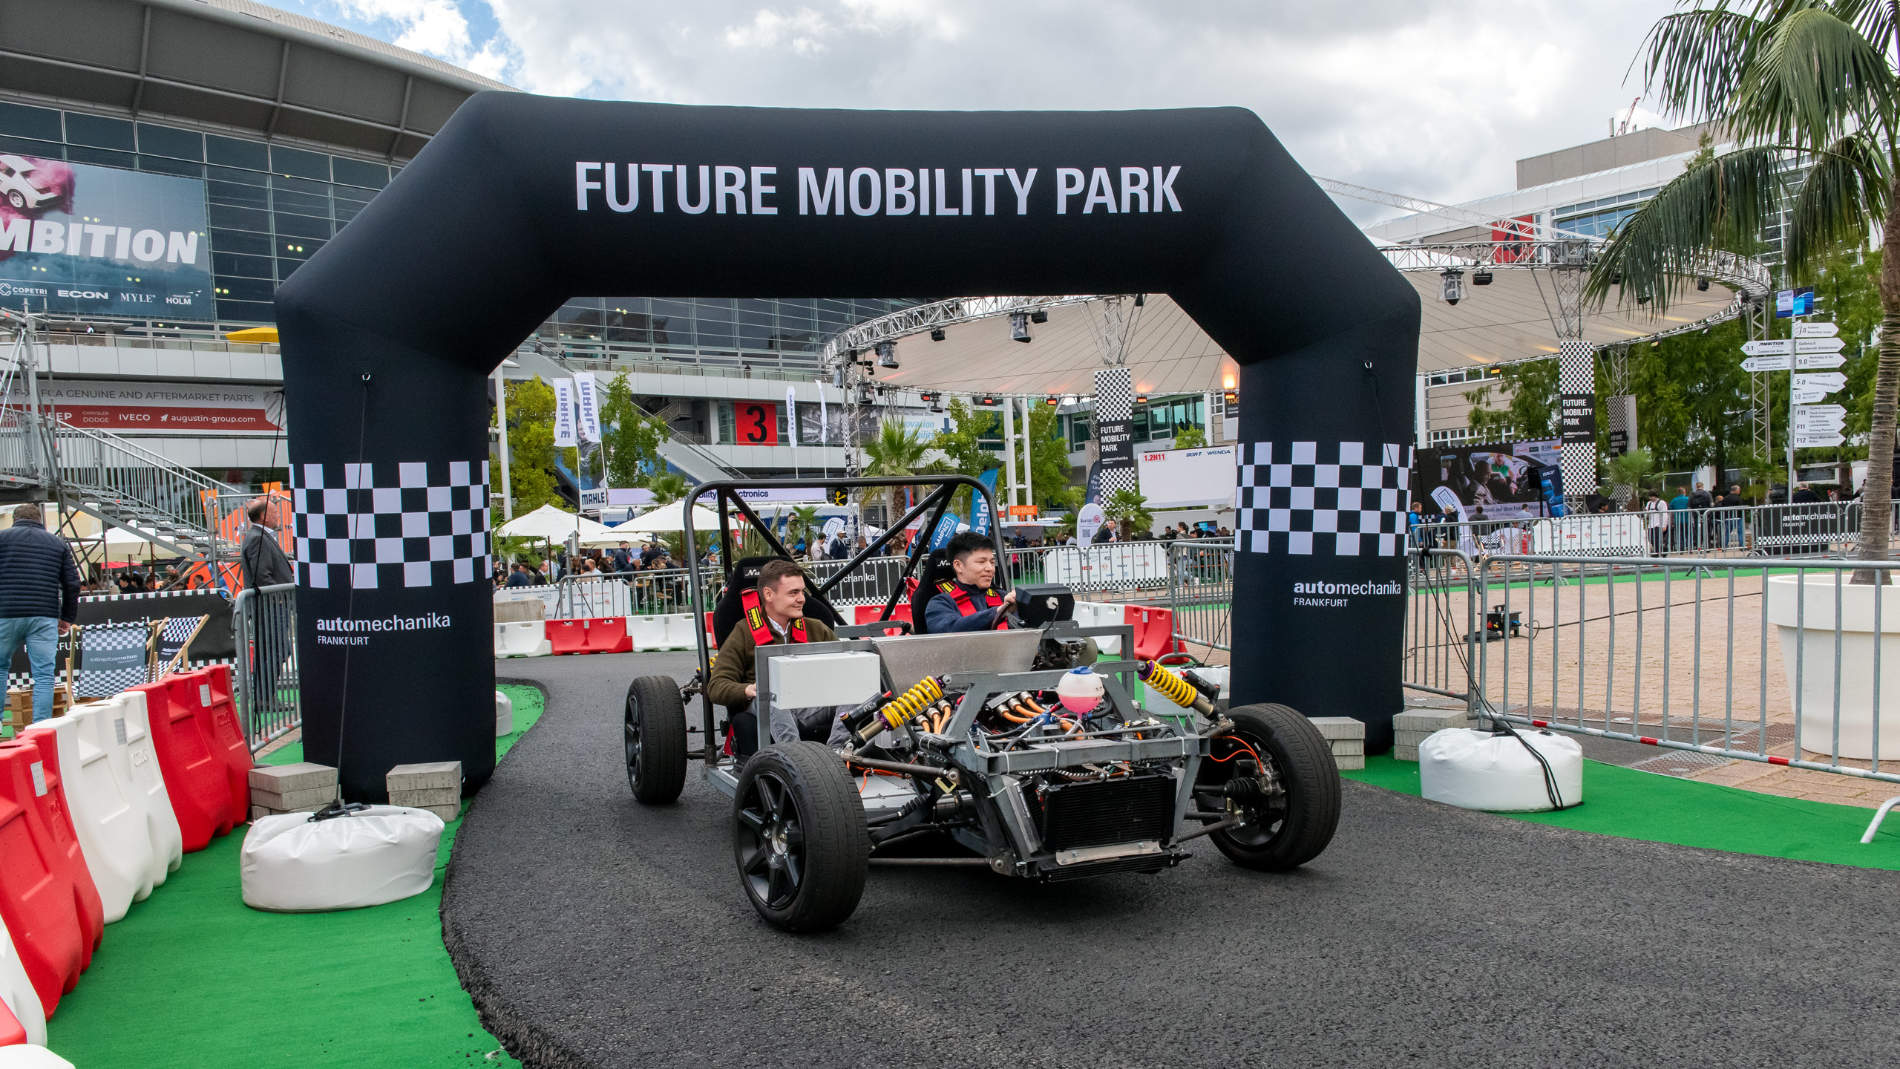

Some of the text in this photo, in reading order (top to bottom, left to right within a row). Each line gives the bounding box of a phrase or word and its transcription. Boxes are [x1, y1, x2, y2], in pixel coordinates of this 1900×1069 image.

[576, 161, 1183, 216] FUTURE MOBILITY PARK
[12, 286, 48, 295] COPETRI
[57, 289, 109, 300] ECON
[165, 297, 192, 305] HOLM
[66, 390, 116, 399] GENUINE
[119, 391, 143, 400] AND
[145, 391, 220, 402] AFTERMARKET
[223, 393, 255, 402] PARTS
[1562, 399, 1587, 407] FUTURE
[1562, 408, 1593, 416] MOBILITY
[119, 413, 151, 421] IVECO
[171, 414, 256, 424] augustin-group.com
[1563, 418, 1580, 426] PARK
[746, 405, 767, 443] 3
[1101, 425, 1125, 434] FUTURE
[1101, 433, 1131, 443] MOBILITY
[1101, 444, 1118, 452] PARK
[581, 492, 605, 505] MAHLE
[1293, 580, 1401, 596] automechanika
[1293, 598, 1349, 608] FRANKFURT
[316, 612, 451, 632] automechanika
[317, 635, 370, 646] FRANKFURT
